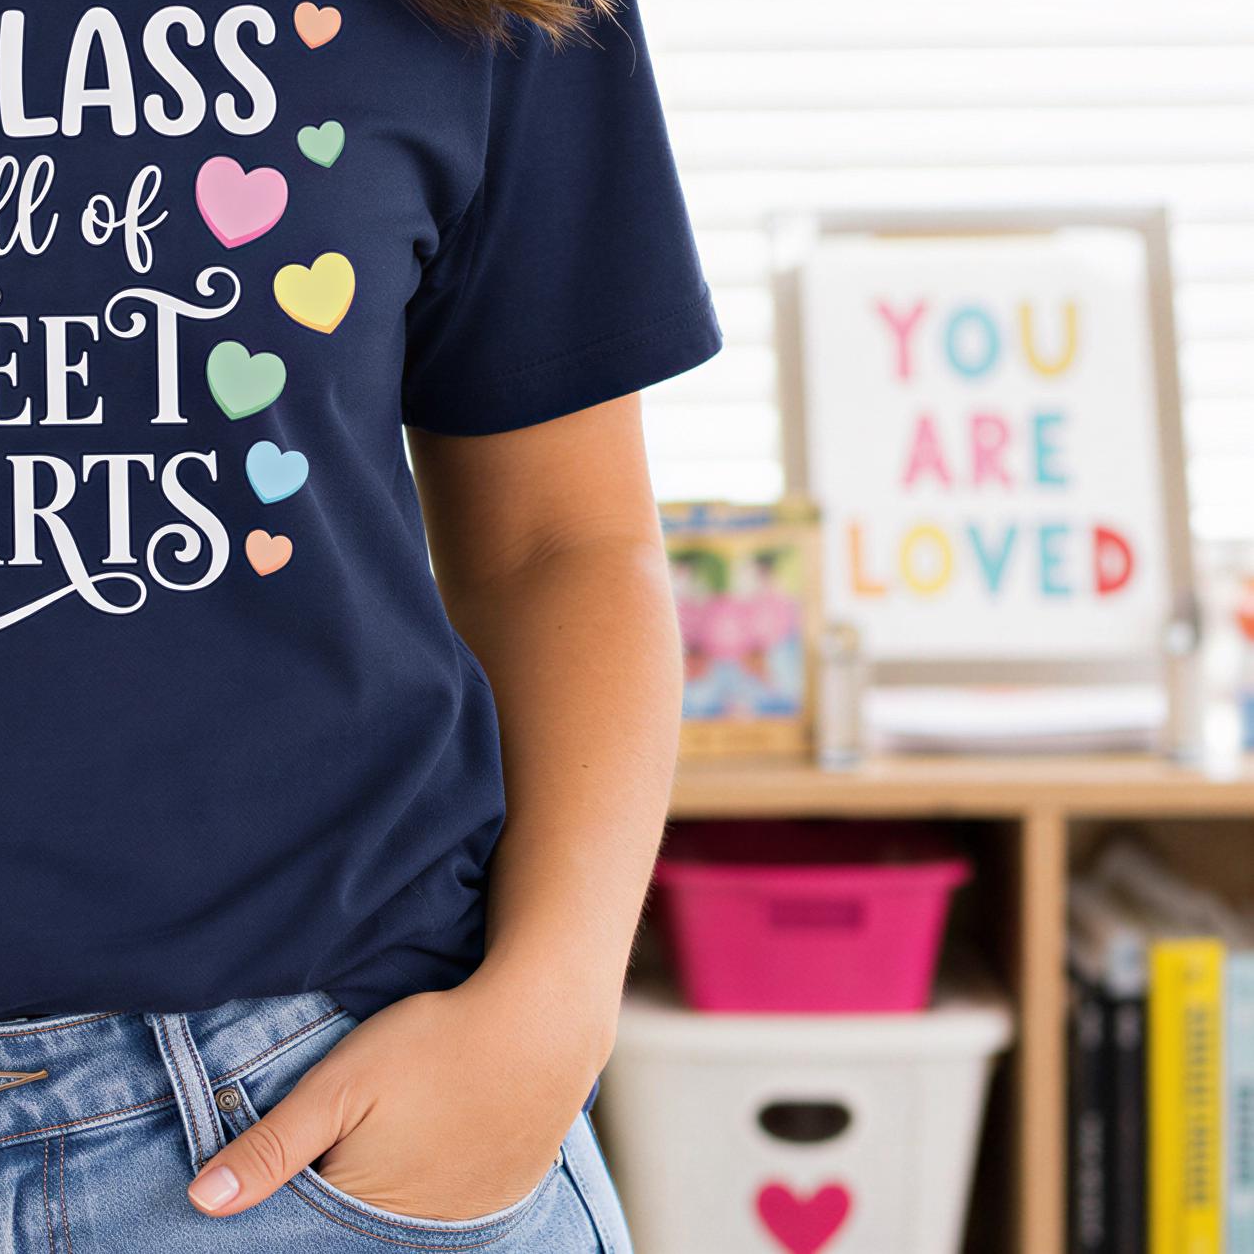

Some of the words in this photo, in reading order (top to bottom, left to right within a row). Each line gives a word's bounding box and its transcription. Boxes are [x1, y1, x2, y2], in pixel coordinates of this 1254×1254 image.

[82, 165, 168, 273] of
[874, 300, 1079, 380] YOU
[902, 411, 1068, 486] ARE
[848, 522, 1136, 596] LOVED
